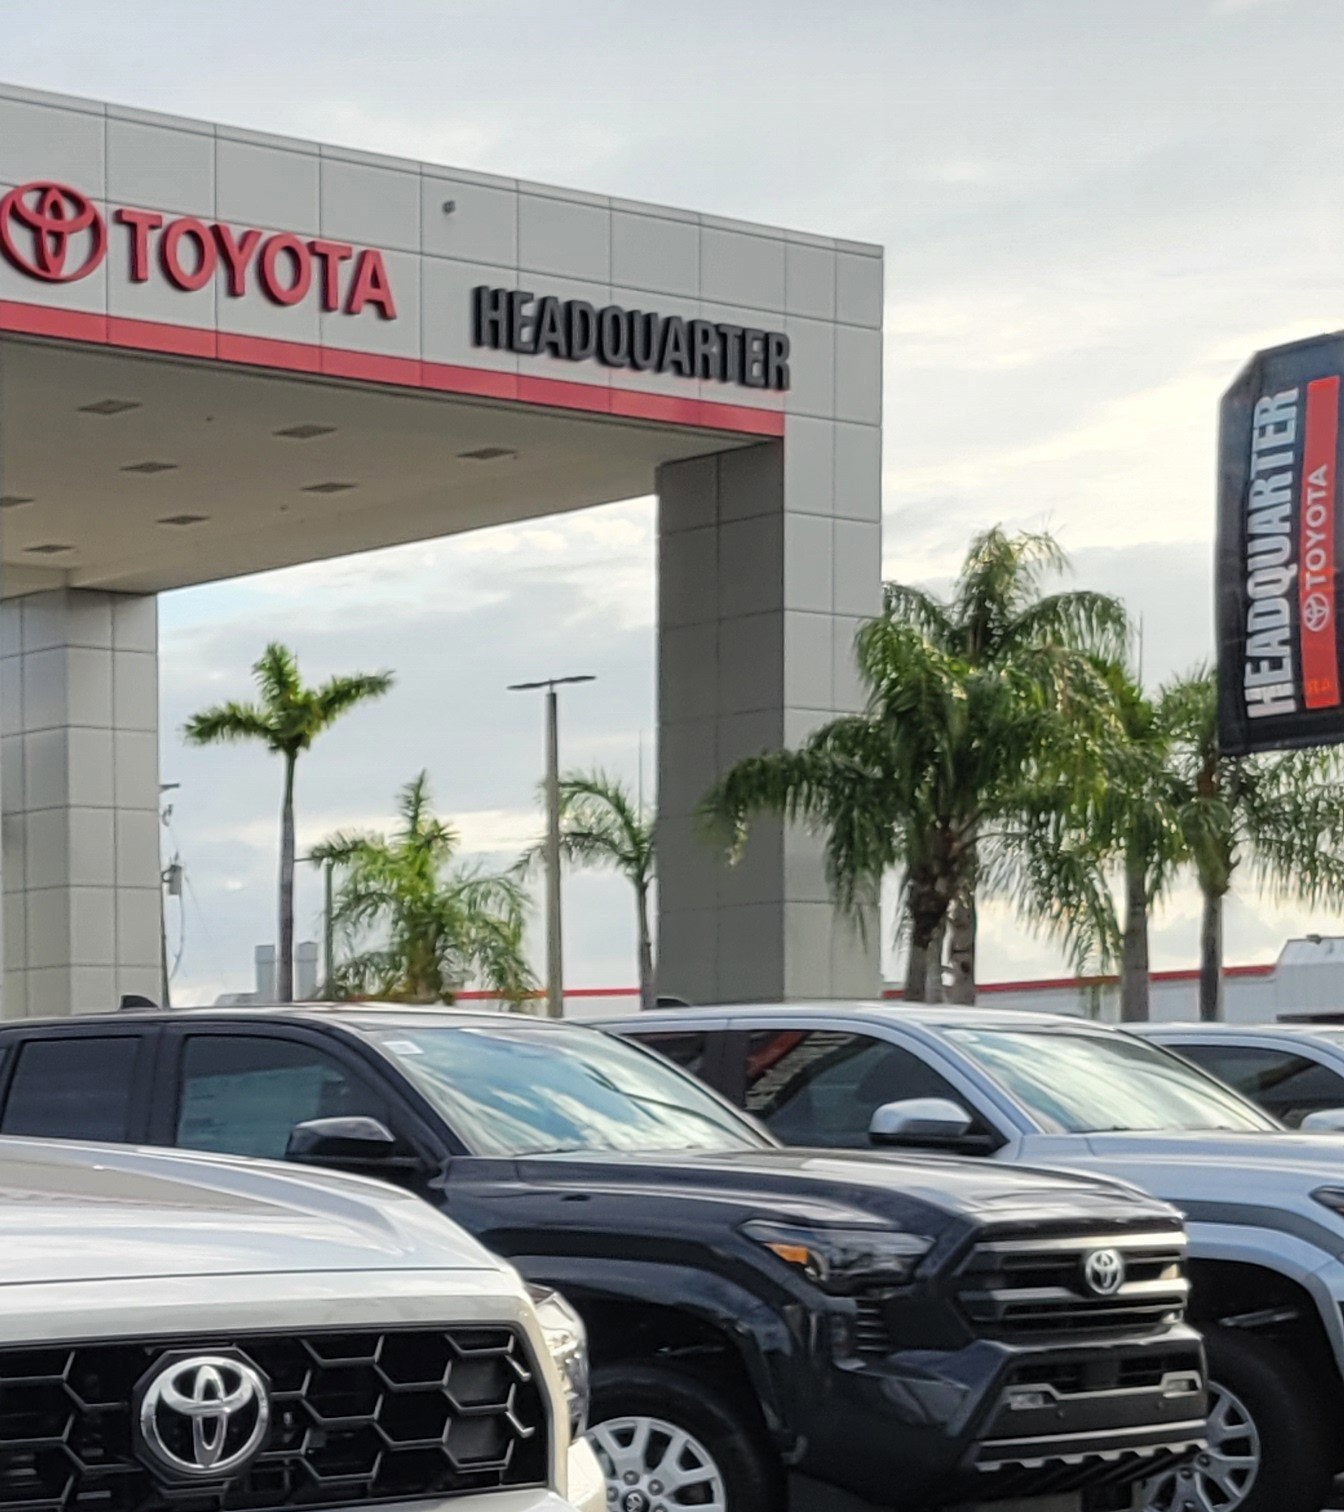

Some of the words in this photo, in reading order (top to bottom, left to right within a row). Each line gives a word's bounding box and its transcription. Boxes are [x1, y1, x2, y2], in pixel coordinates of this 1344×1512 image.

[115, 208, 396, 319] TOYOTA
[471, 285, 791, 391] HEADQUARTER
[1243, 387, 1300, 718] HEADQUARTER
[1304, 465, 1327, 588] TOYOTA
